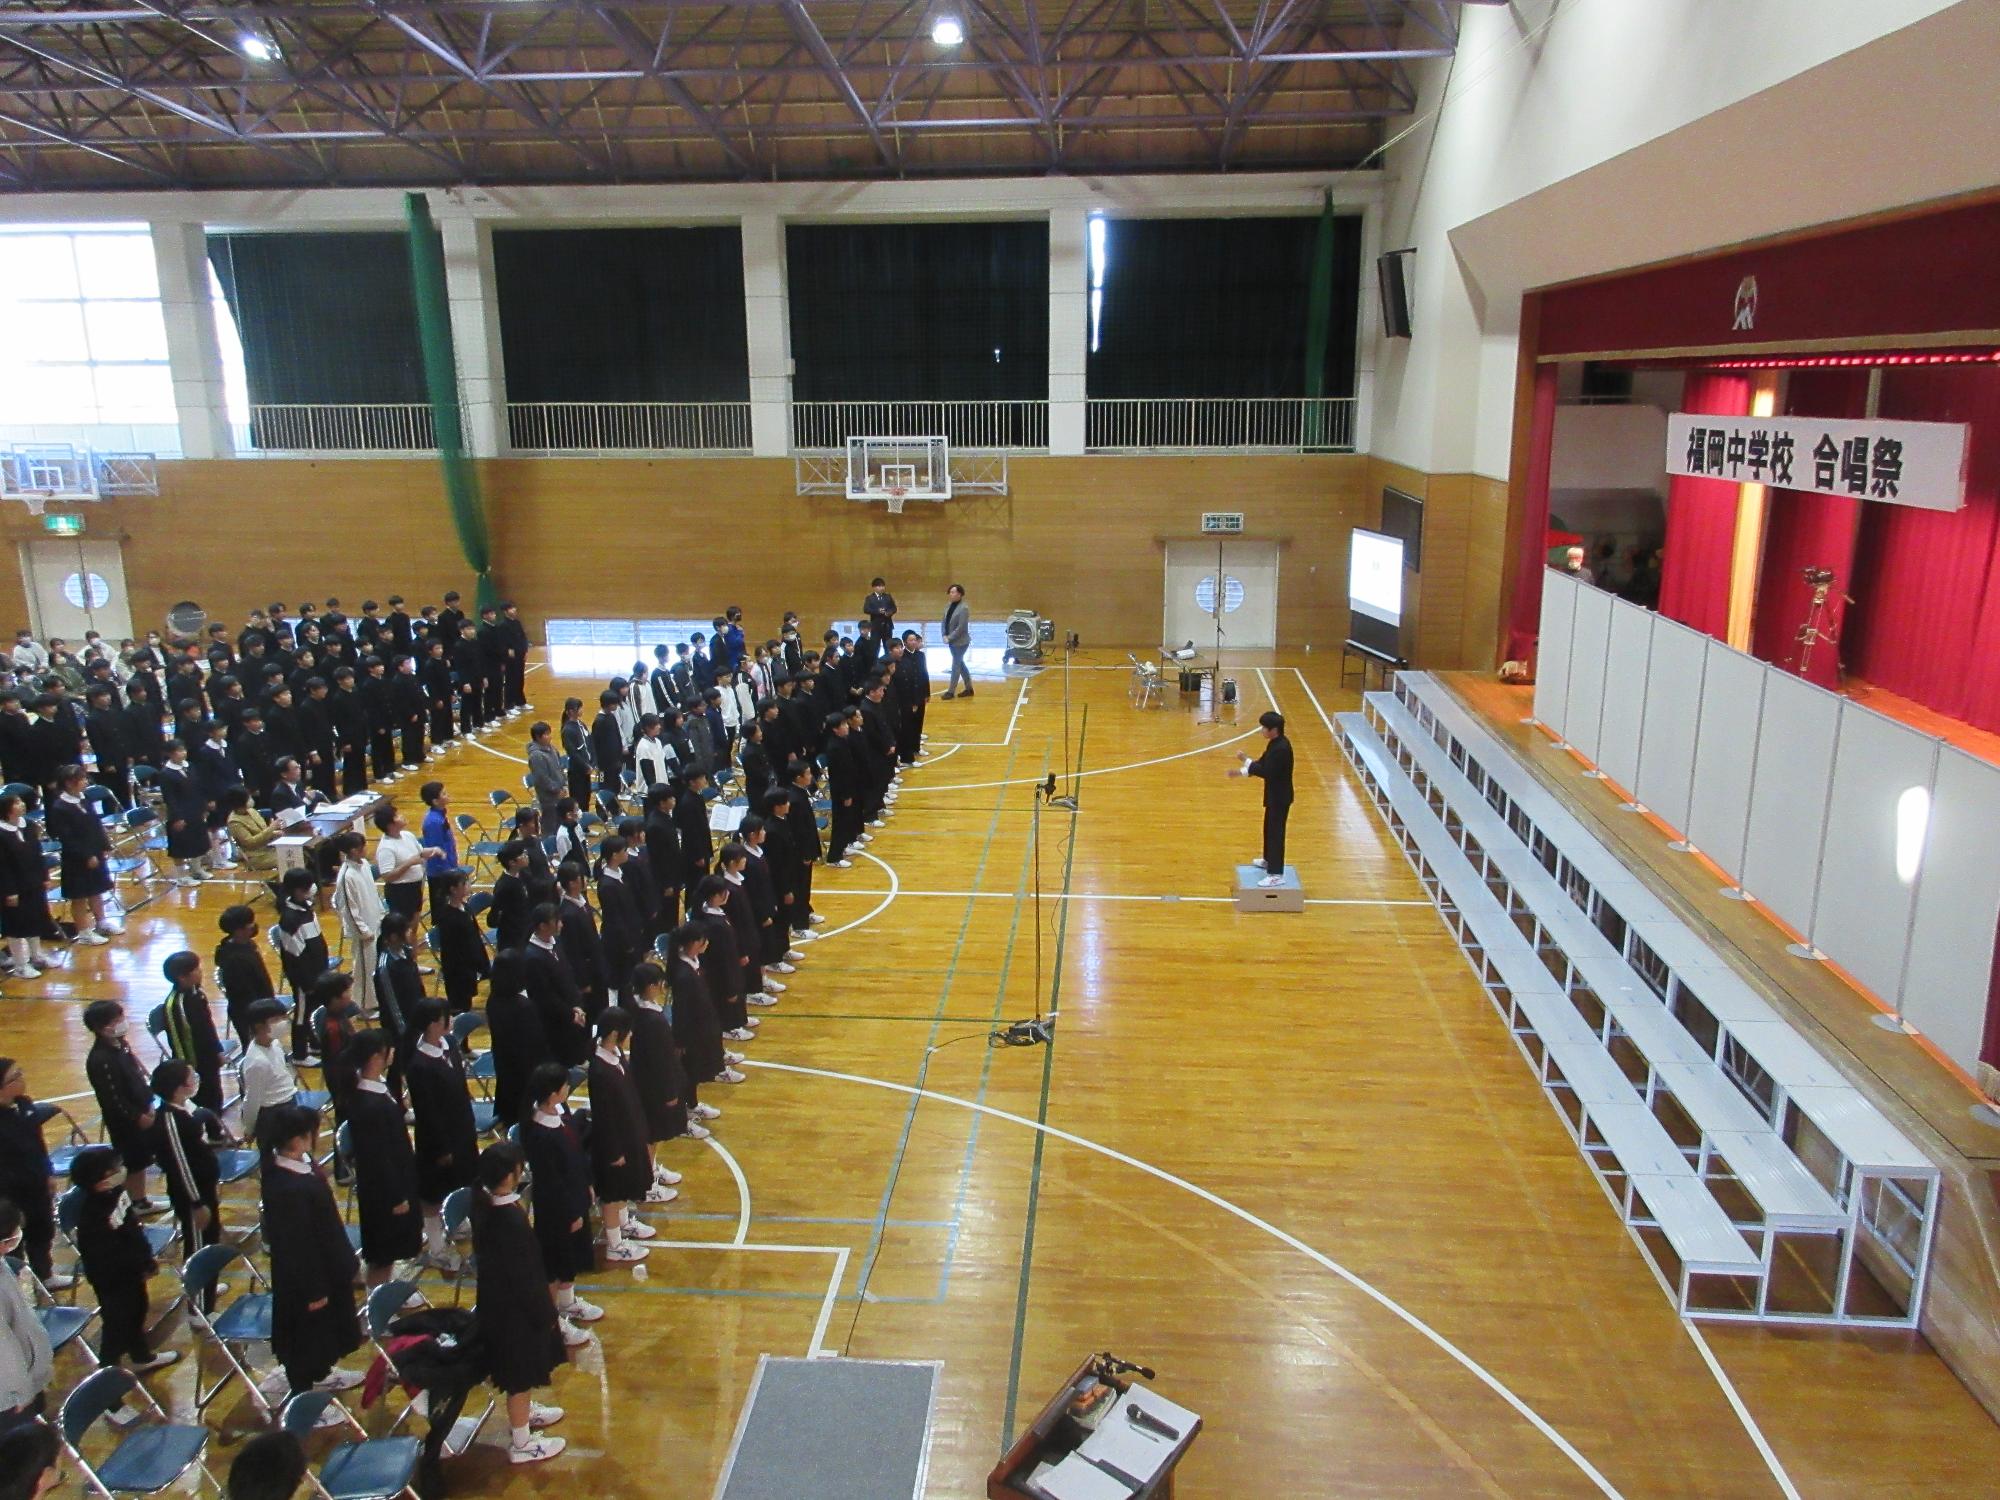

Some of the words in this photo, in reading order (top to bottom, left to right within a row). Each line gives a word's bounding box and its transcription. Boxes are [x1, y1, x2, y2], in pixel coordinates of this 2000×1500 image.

[1687, 427, 1794, 485] 福岡中学校
[1813, 433, 1903, 498] 合唱祭
